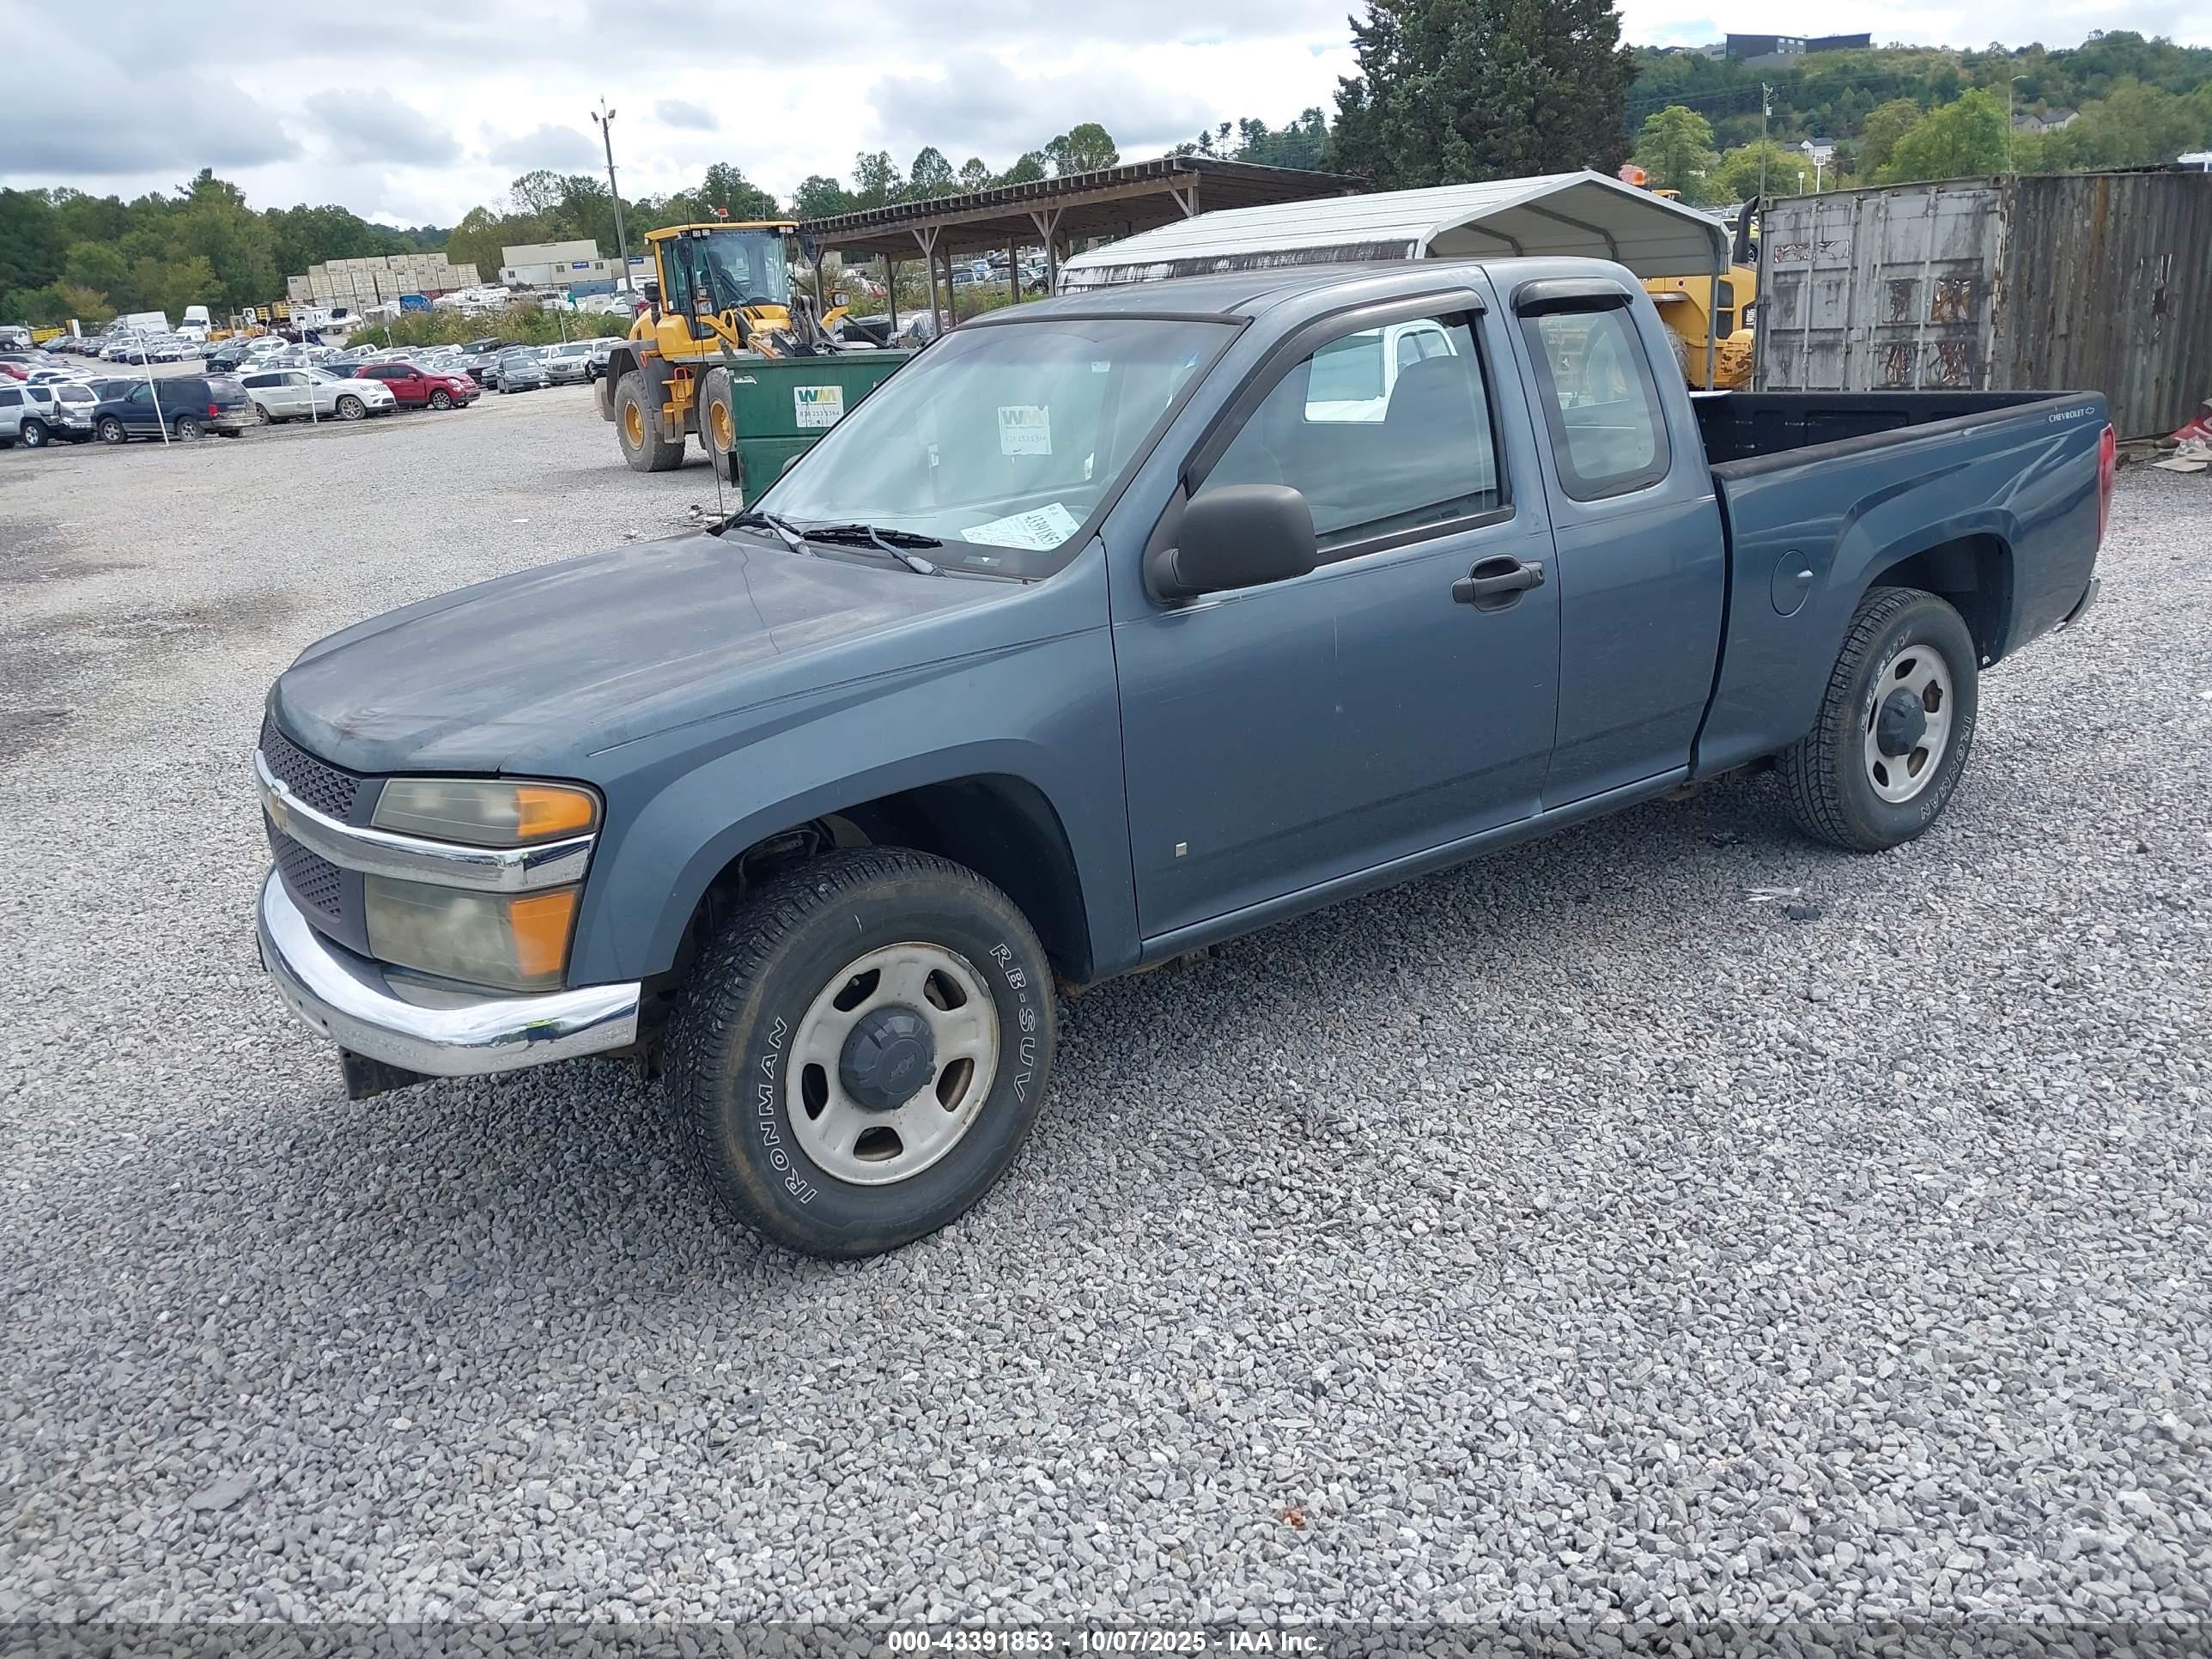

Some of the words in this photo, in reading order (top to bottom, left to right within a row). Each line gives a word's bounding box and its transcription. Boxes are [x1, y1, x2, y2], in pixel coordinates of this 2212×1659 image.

[797, 389, 839, 403] WM
[2048, 409, 2085, 422] CHEVROLET
[1920, 715, 1974, 821] IRONMAN
[989, 943, 1036, 1103] RB-SUV
[757, 1017, 818, 1206] IRONMAN
